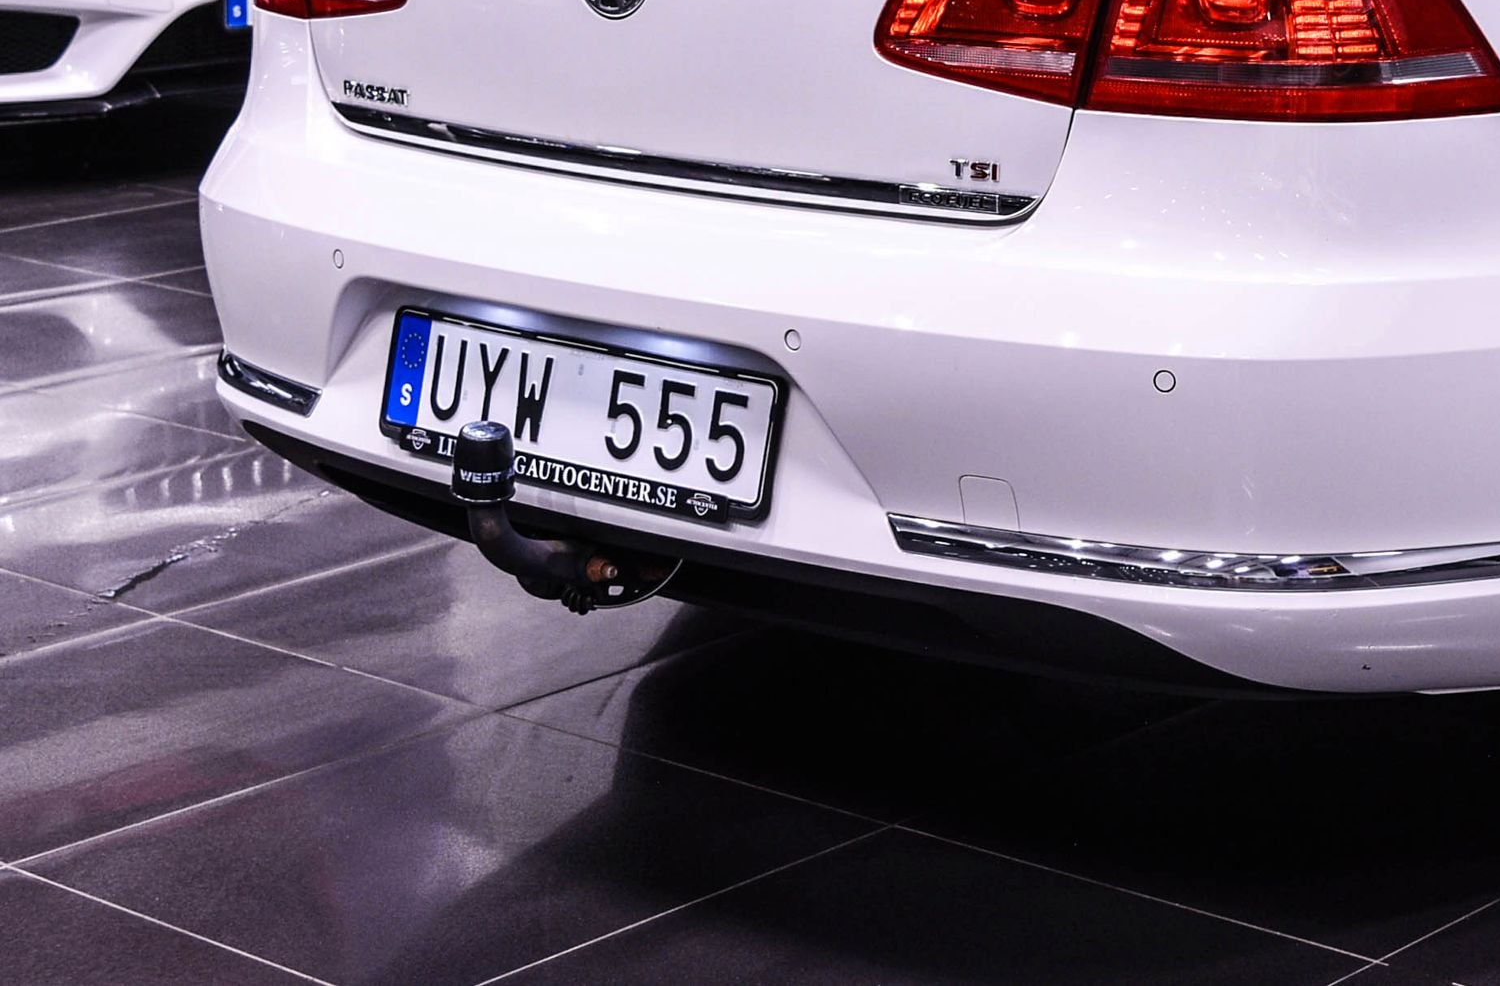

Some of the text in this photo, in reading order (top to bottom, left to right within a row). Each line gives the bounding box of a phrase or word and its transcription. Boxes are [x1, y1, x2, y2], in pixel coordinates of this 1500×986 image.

[232, 5, 242, 18] S
[343, 79, 410, 107] PASSAT
[949, 158, 1000, 182] TSI
[399, 382, 413, 407] S
[430, 334, 749, 482] UYW 555
